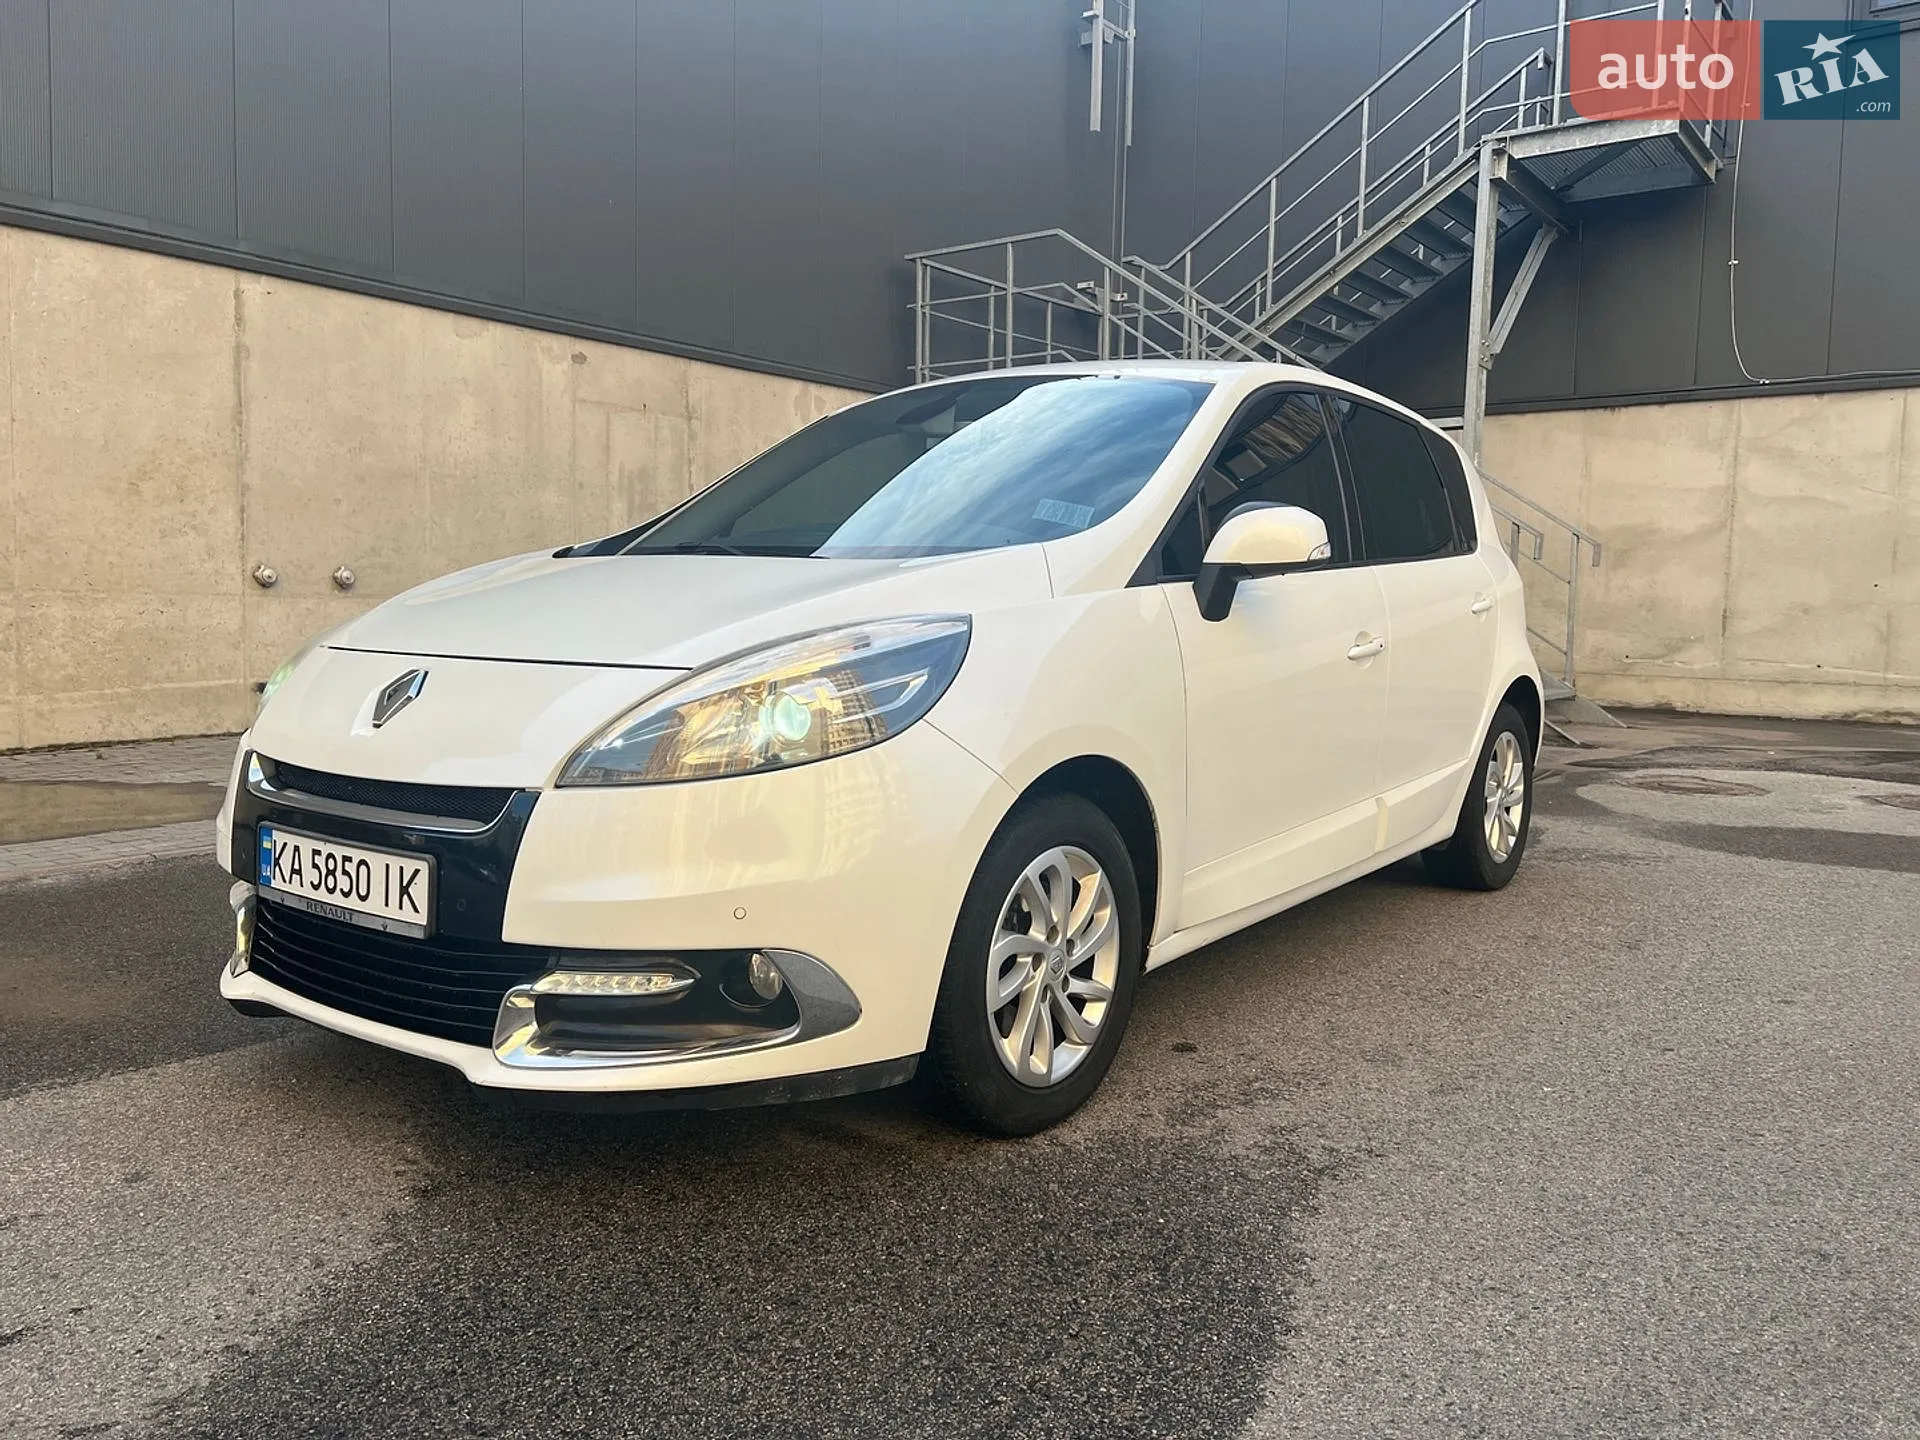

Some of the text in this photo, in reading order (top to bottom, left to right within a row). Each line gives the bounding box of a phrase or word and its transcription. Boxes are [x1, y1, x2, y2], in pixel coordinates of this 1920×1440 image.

[273, 839, 422, 914] KA 5850 IK
[306, 901, 354, 922] RENAULT
